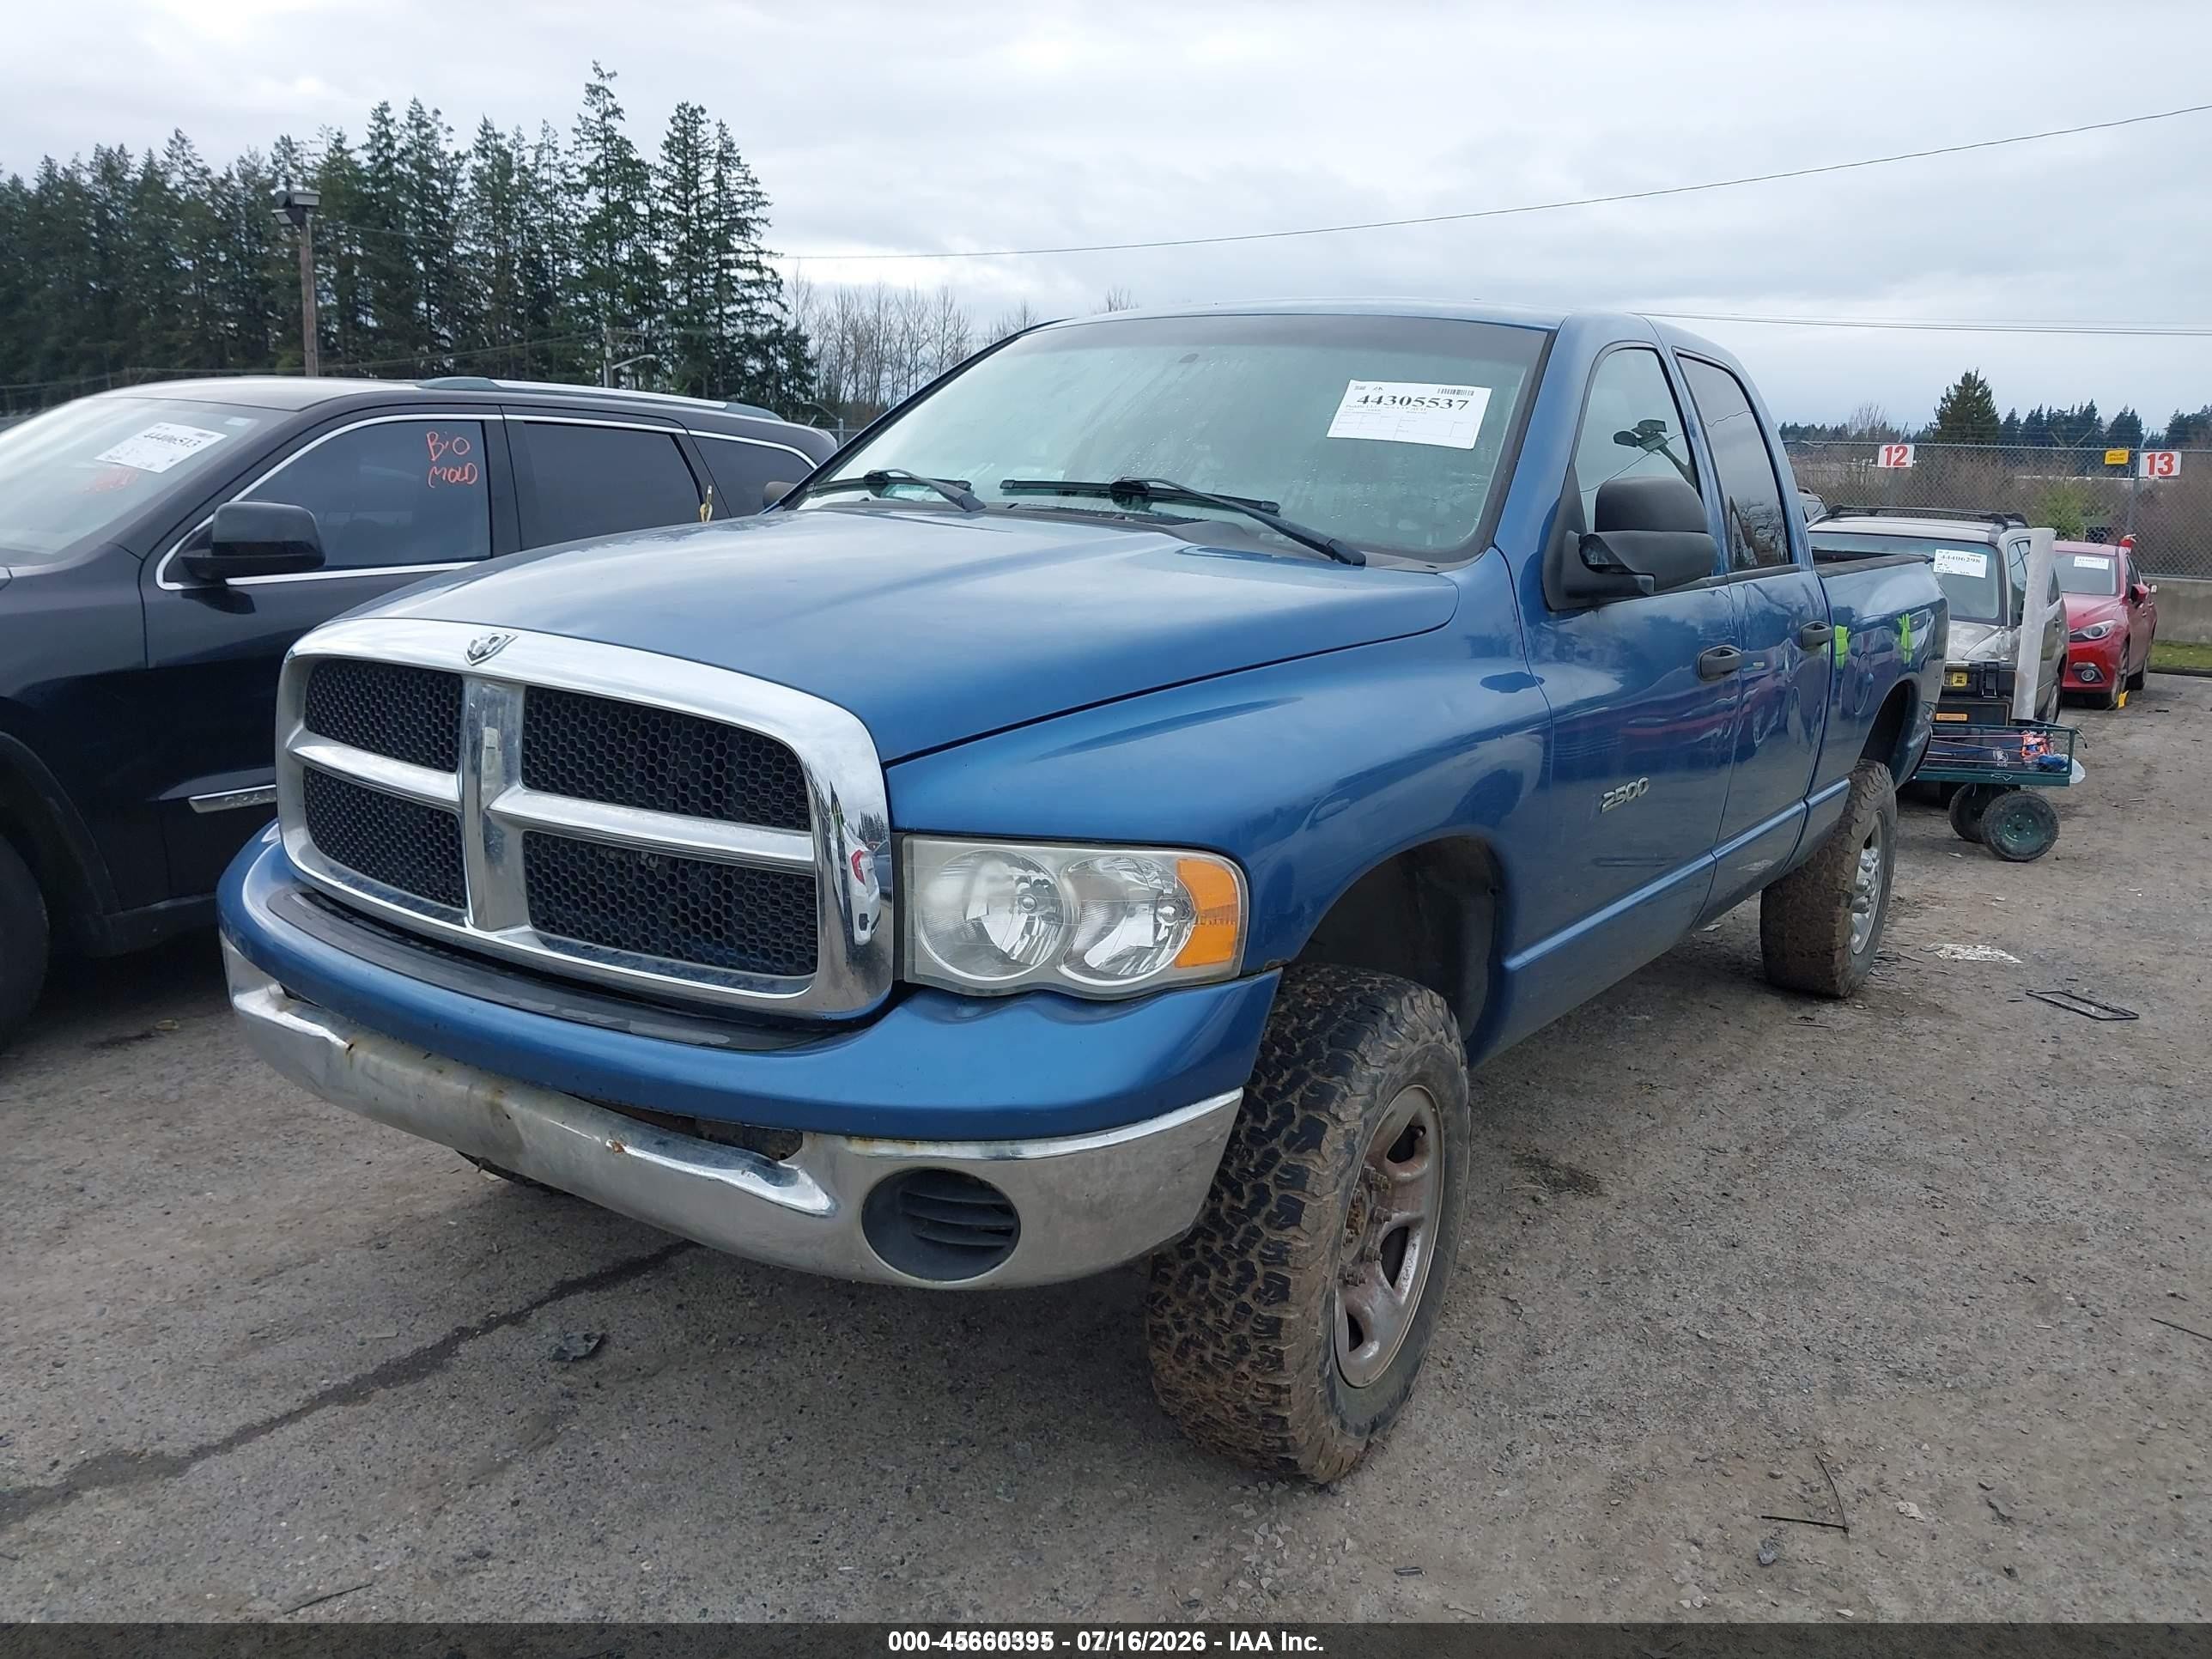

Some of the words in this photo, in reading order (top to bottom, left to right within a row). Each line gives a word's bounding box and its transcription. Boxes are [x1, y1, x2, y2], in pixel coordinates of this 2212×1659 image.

[1357, 394, 1469, 411] 44305537
[1884, 445, 1908, 466] 12
[2147, 452, 2175, 476] 13
[1601, 776, 1650, 813] 2500
